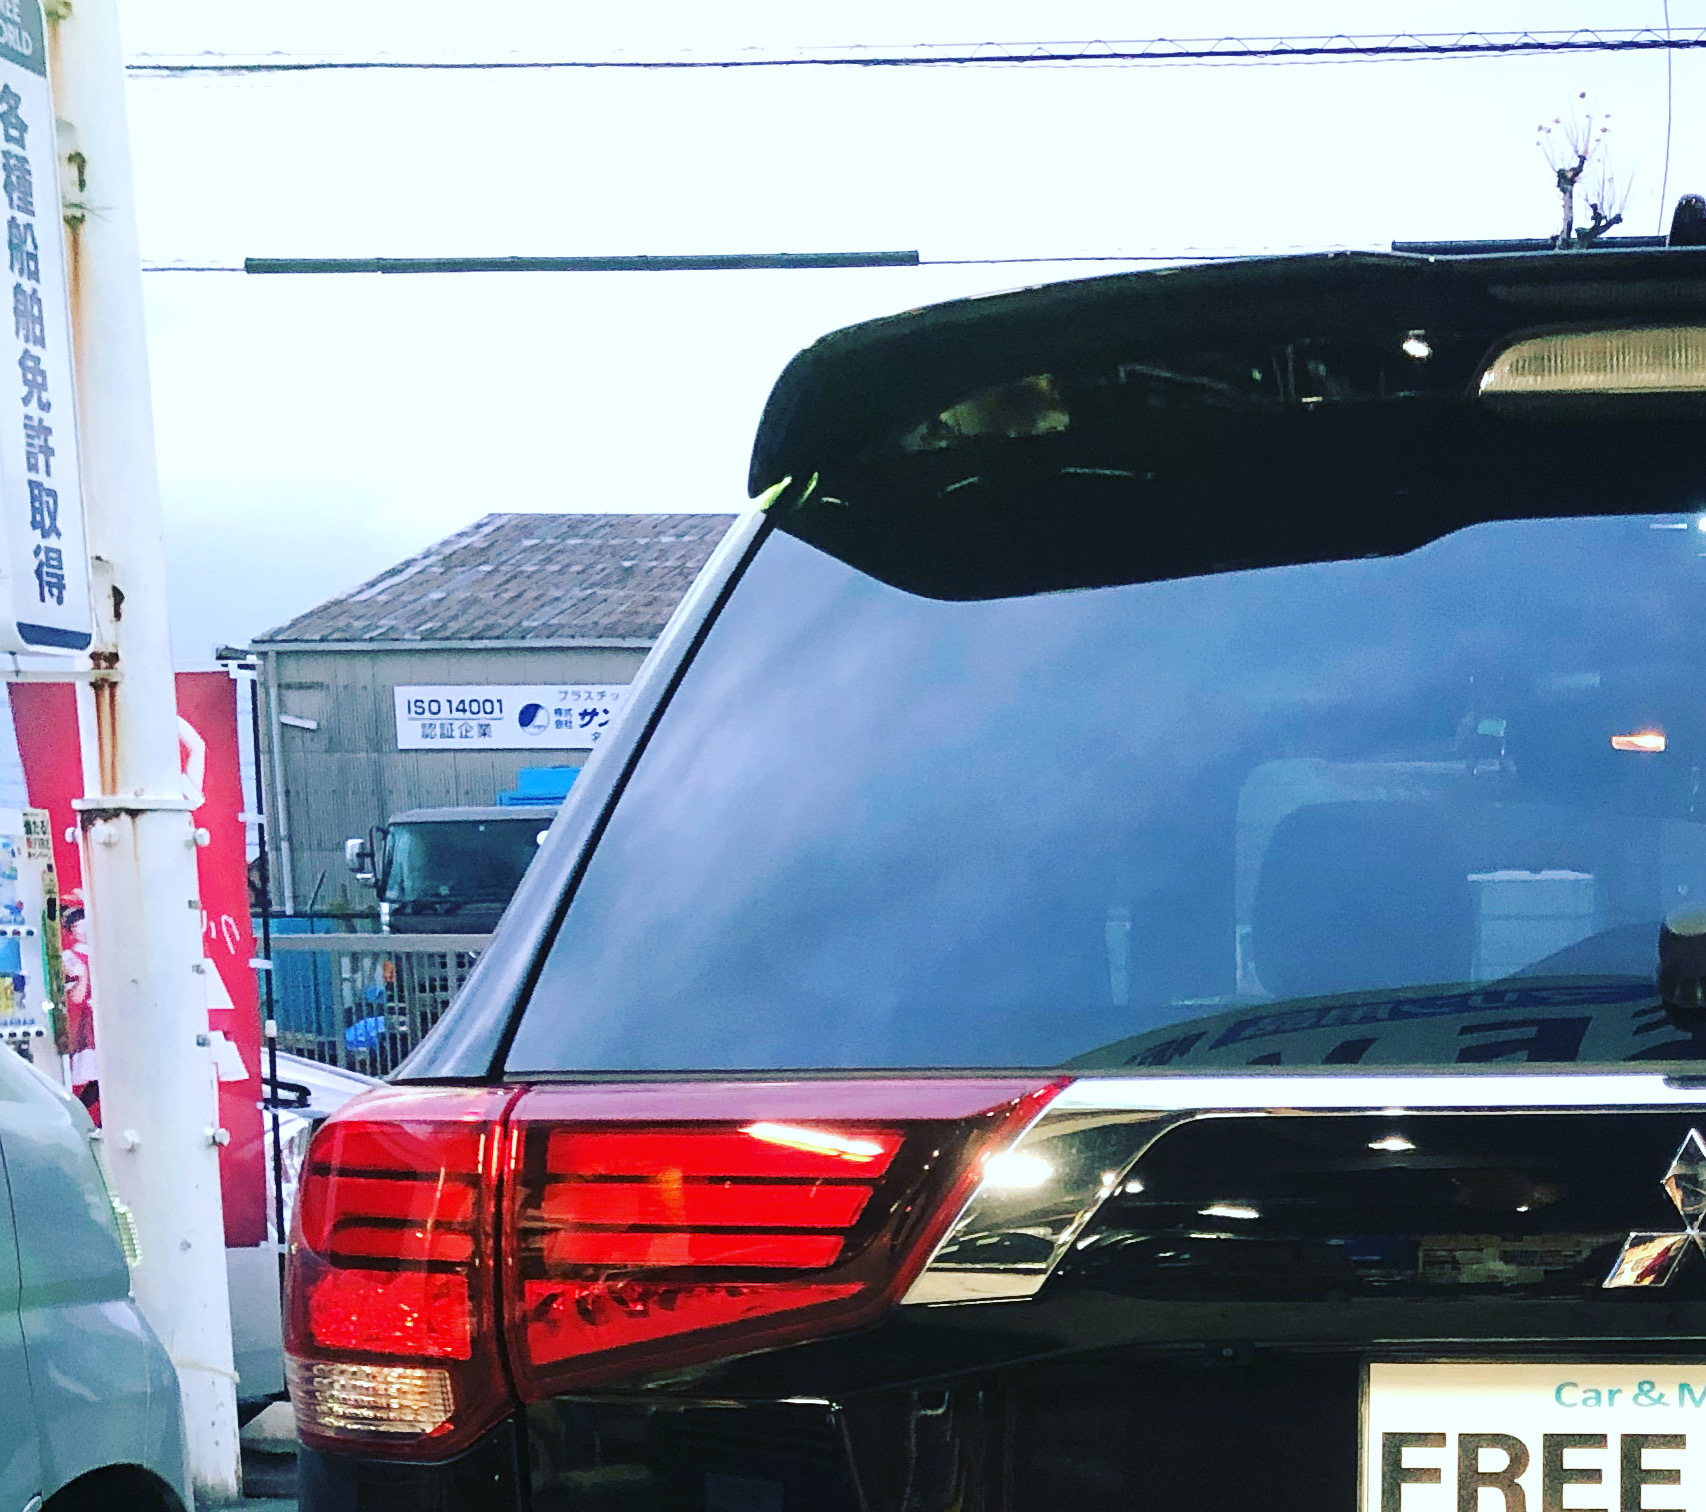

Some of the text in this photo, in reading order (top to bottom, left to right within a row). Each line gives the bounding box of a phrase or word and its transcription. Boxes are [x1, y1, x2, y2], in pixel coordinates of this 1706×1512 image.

[0, 83, 67, 606] 各種船舶免許取得
[1555, 1380, 1622, 1409] Car
[1631, 1379, 1670, 1408] &
